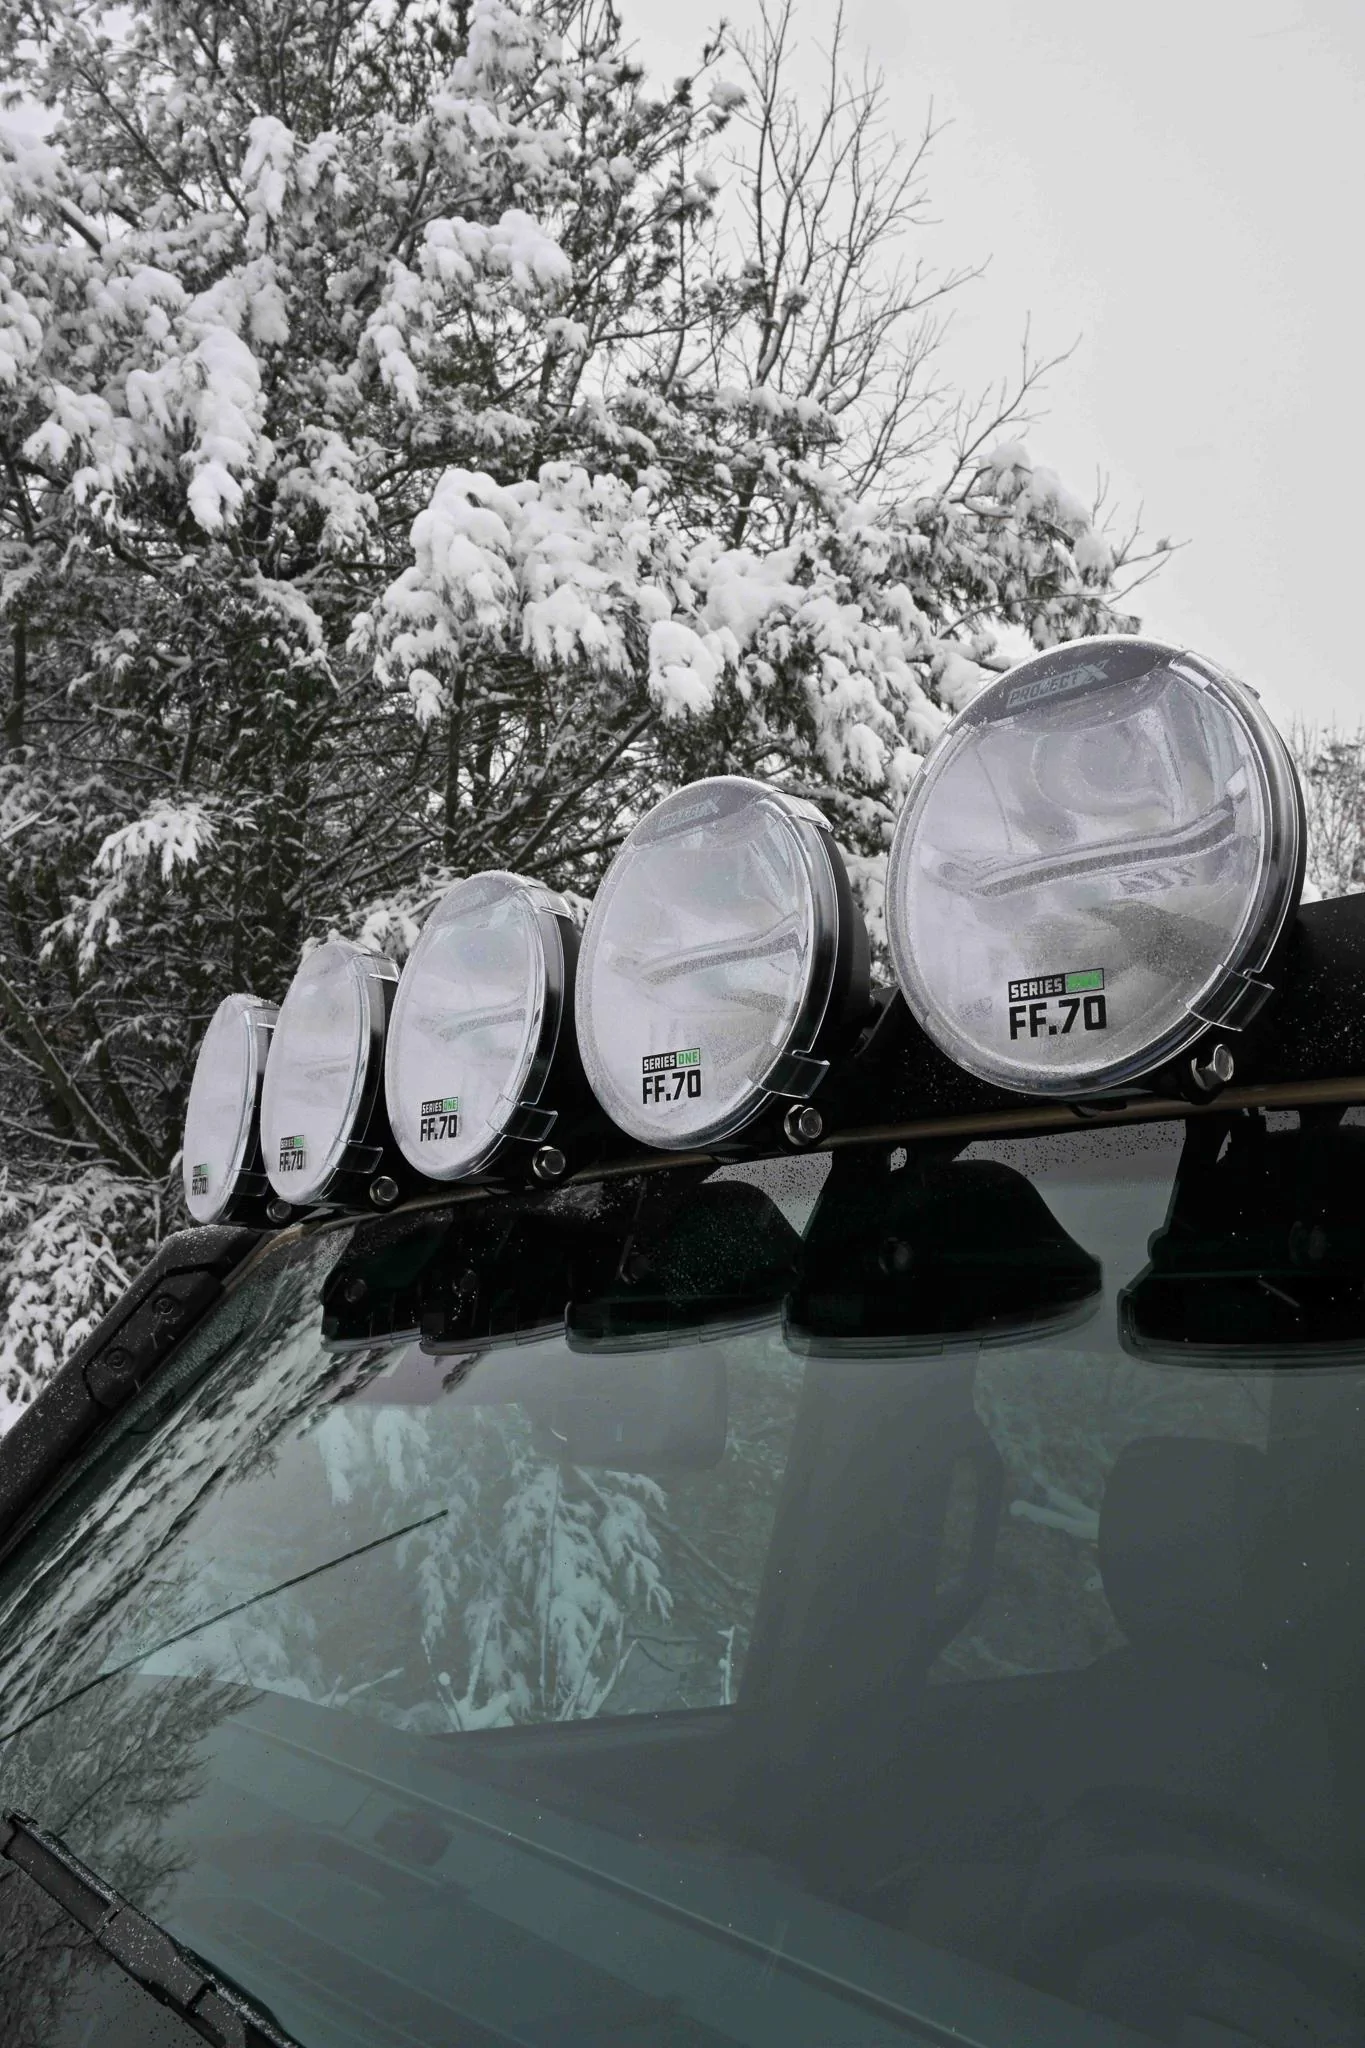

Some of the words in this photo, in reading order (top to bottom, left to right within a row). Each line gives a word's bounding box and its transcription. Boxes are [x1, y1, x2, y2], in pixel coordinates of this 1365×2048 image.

[1010, 978, 1063, 999] SERIES
[1009, 995, 1107, 1040] FF.70
[643, 1054, 676, 1071] SERIES
[678, 1051, 698, 1065] ONE
[642, 1069, 701, 1105] FF.70
[420, 1114, 458, 1142] FF.70
[279, 1150, 303, 1172] FF.70
